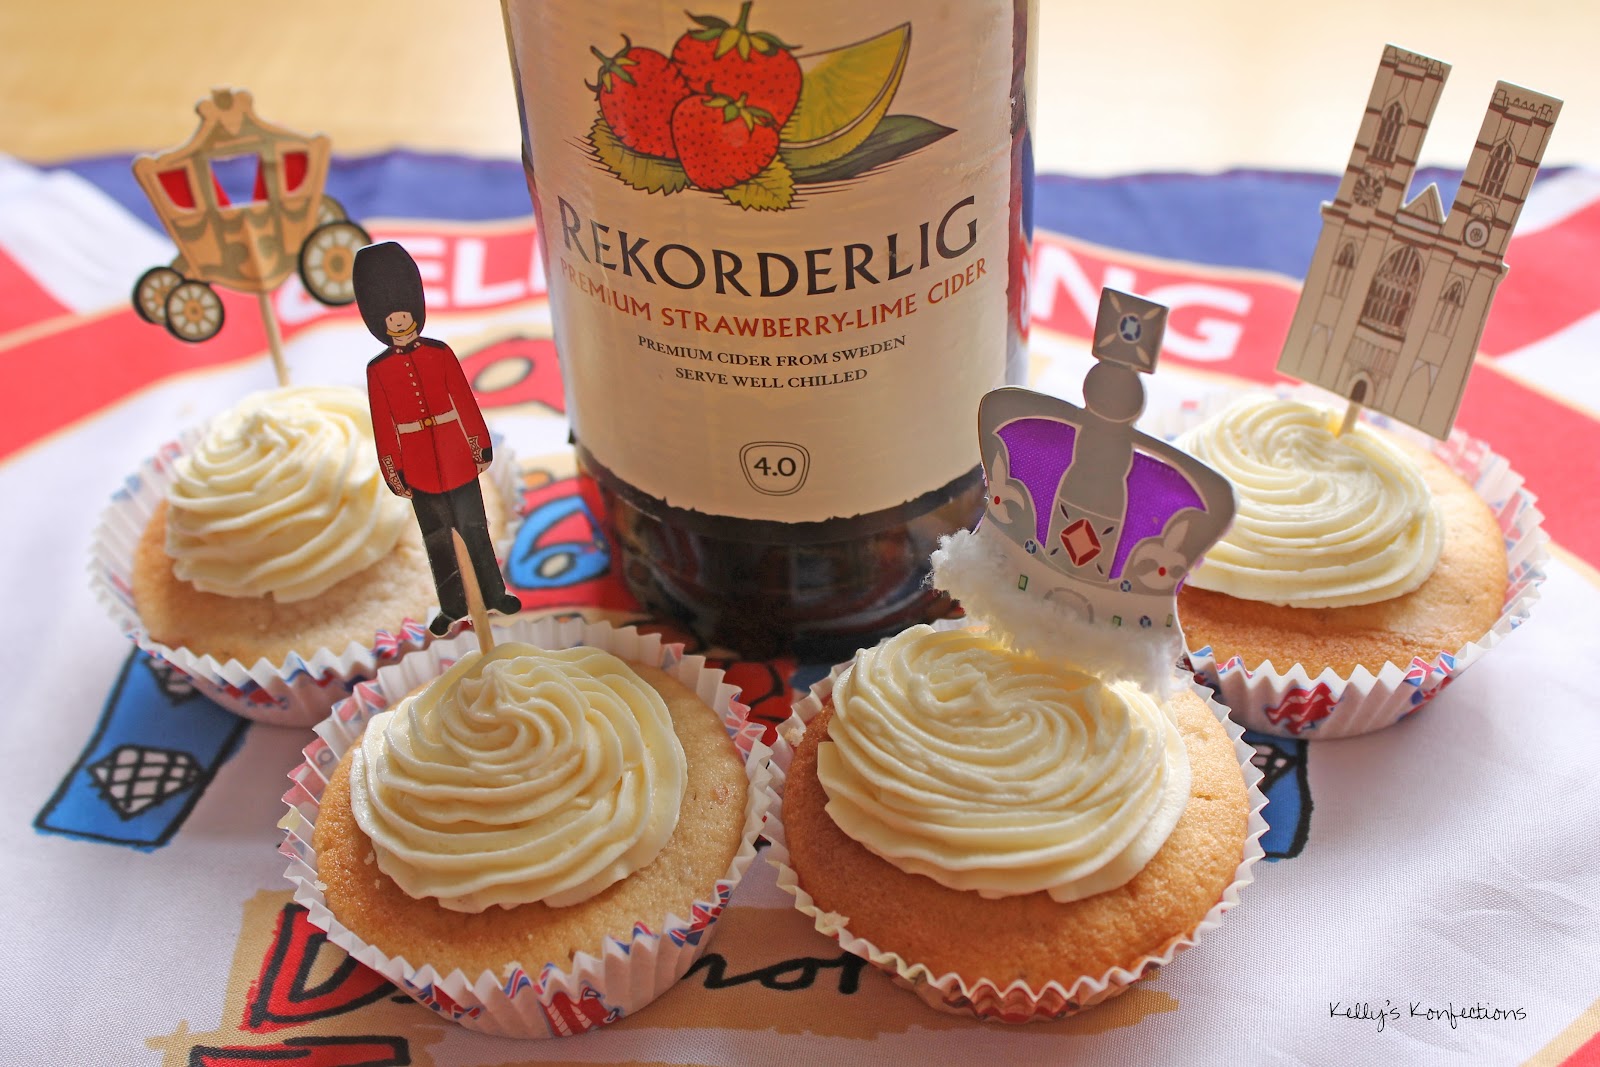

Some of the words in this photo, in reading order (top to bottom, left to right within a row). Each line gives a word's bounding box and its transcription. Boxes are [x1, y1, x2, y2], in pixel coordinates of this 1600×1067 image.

[557, 194, 978, 298] REKORDERLIG
[560, 256, 652, 322] PREMIUM
[660, 292, 919, 339] STRAWBERRY-LIME
[927, 257, 987, 305] CIDER
[637, 334, 714, 363] PREMIUM
[716, 351, 772, 367] CIDER
[776, 353, 829, 368] FROM
[831, 334, 907, 364] SWEDEN
[675, 367, 729, 386] SERVE
[732, 374, 784, 389] WELL
[787, 367, 868, 389] CHILLED
[752, 456, 797, 478] 4.0
